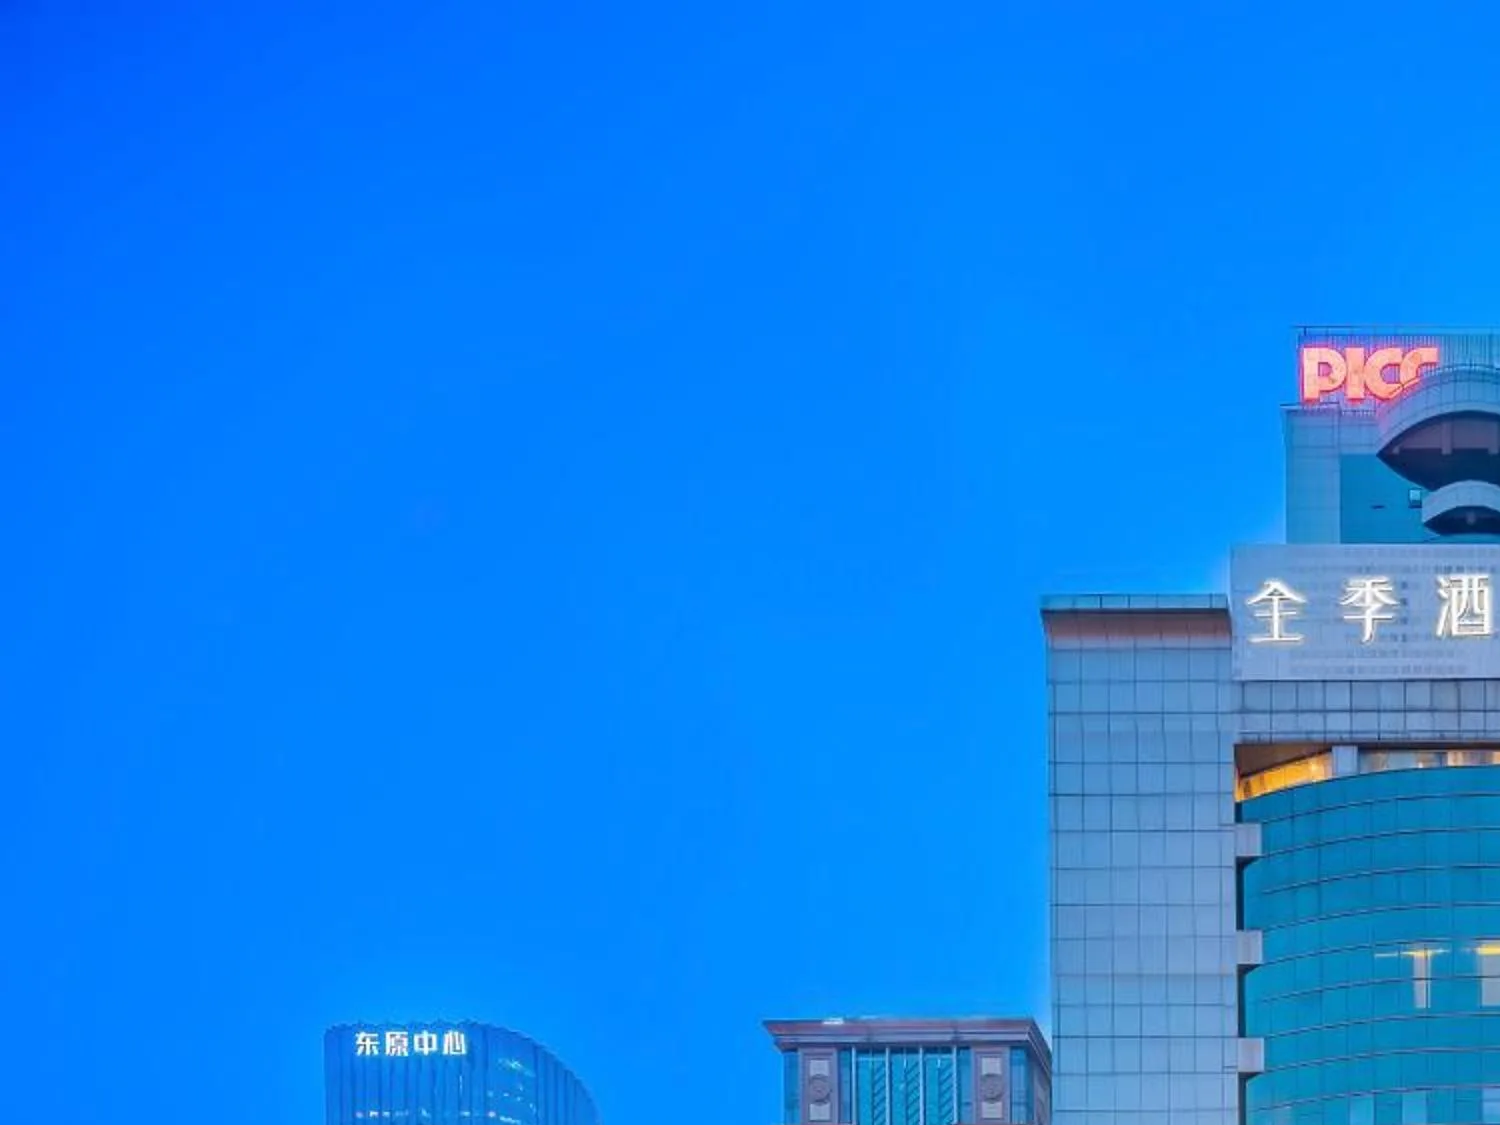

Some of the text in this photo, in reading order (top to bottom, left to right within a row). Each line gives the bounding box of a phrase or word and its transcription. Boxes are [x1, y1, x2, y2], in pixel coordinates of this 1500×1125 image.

[1303, 346, 1438, 401] PICC
[355, 1031, 467, 1056] 东原中心
